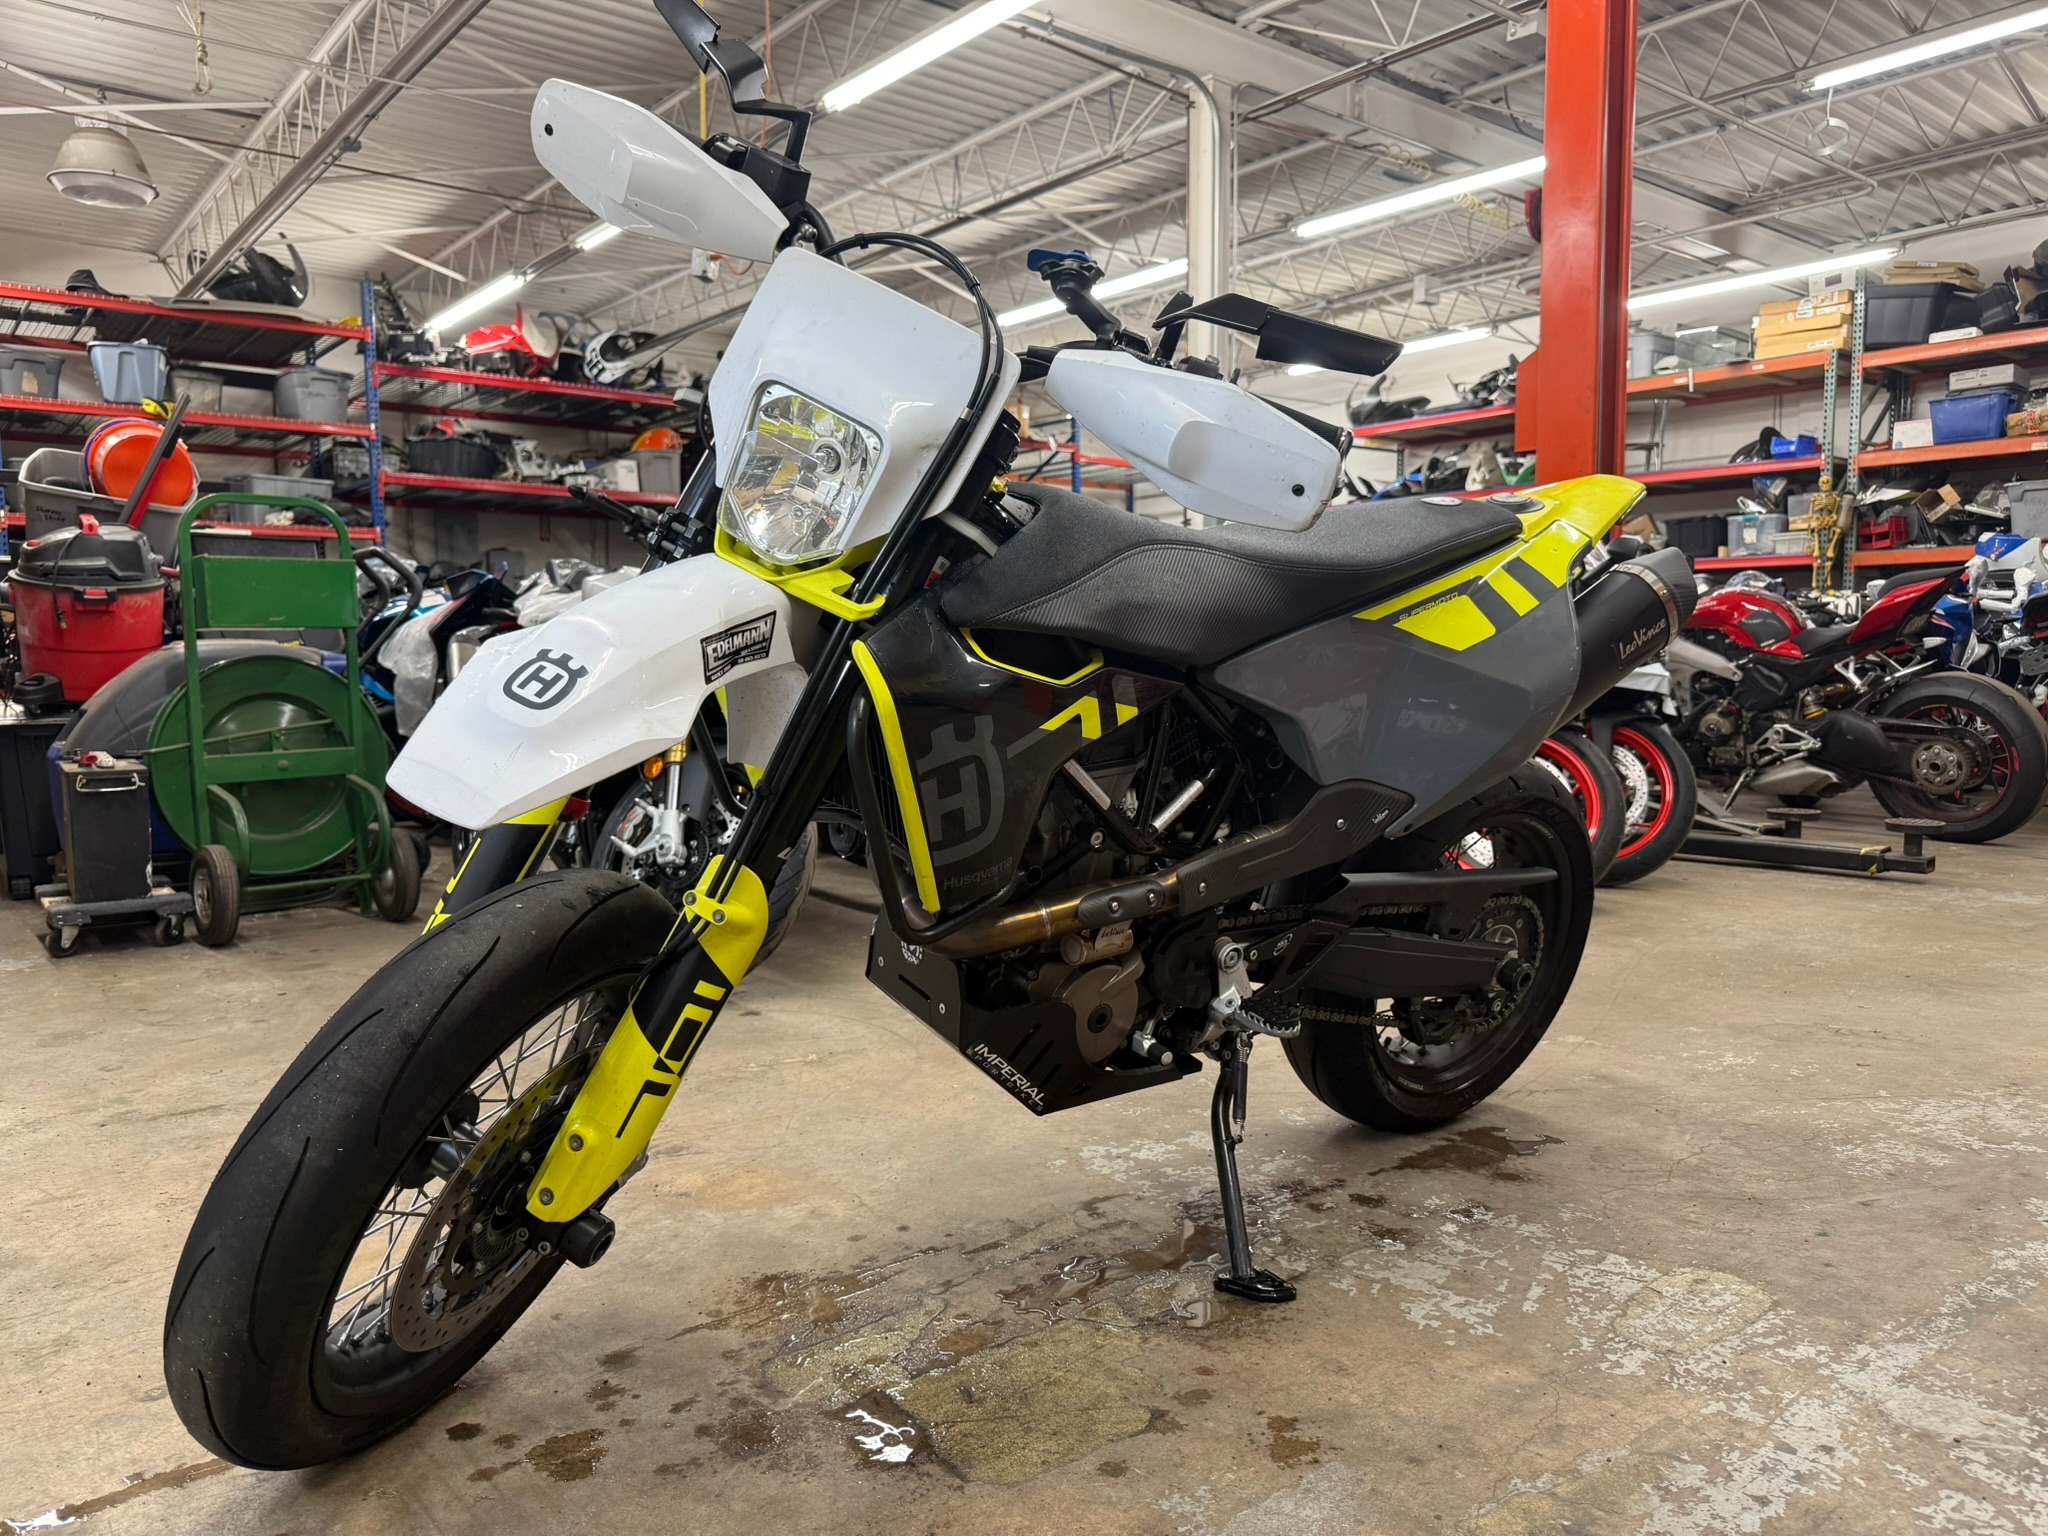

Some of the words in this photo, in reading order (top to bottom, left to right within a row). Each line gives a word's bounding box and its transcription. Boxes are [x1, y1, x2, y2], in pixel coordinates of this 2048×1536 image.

[1399, 591, 1459, 622] SUPERMOTO
[706, 618, 771, 670] EDELMANN
[1618, 617, 1668, 661] LeoVince
[943, 856, 1013, 890] Husqvarna
[974, 1043, 1046, 1106] IMPERIAL
